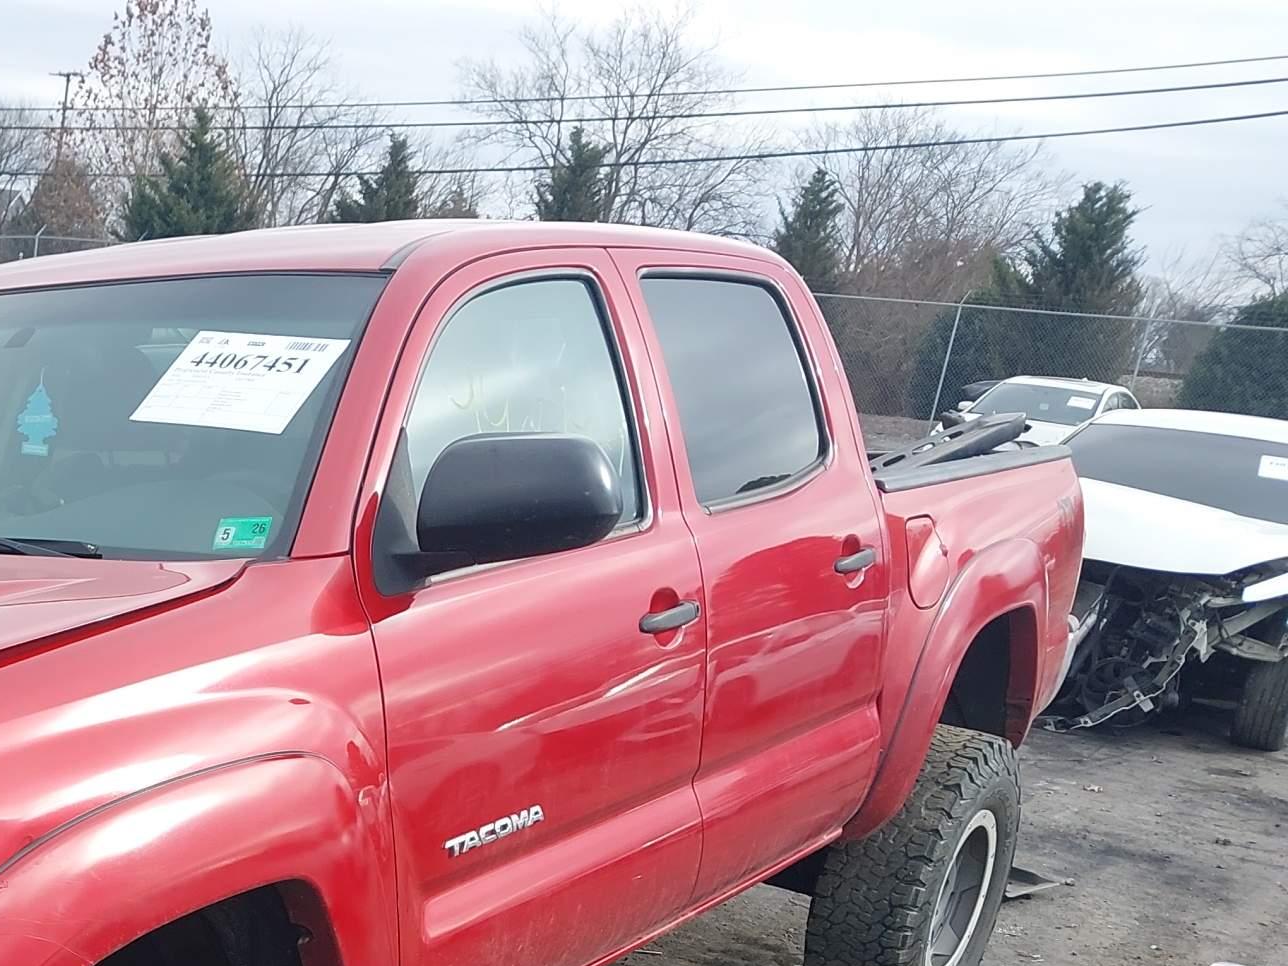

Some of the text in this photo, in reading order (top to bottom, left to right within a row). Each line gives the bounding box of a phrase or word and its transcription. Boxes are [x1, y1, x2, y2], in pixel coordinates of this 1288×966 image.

[190, 350, 310, 374] 44067451
[221, 523, 267, 541] 5 26
[443, 805, 545, 857] TACOMA
